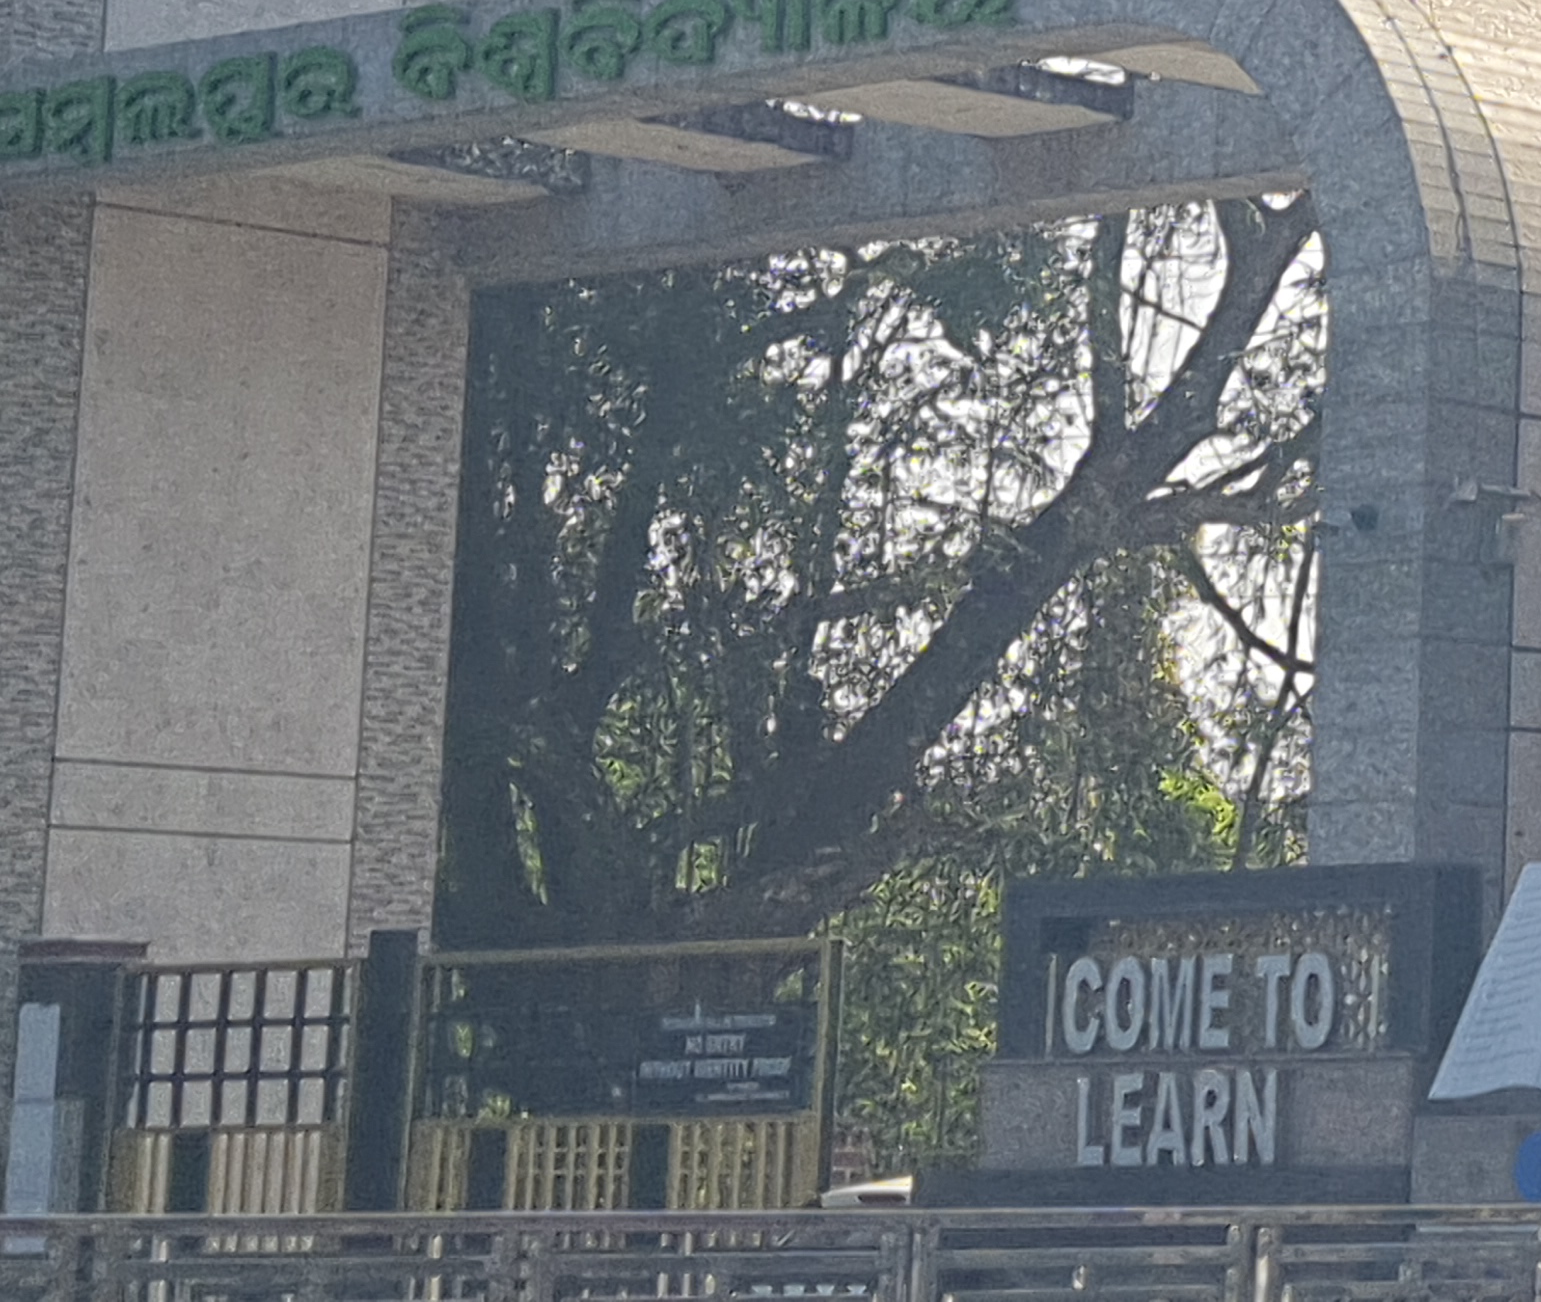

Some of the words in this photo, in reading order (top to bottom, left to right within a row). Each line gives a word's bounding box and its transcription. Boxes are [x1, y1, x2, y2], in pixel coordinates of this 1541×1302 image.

[1062, 952, 1233, 1055] COME
[1255, 951, 1335, 1051] TO
[1077, 1067, 1279, 1167] LEARN
